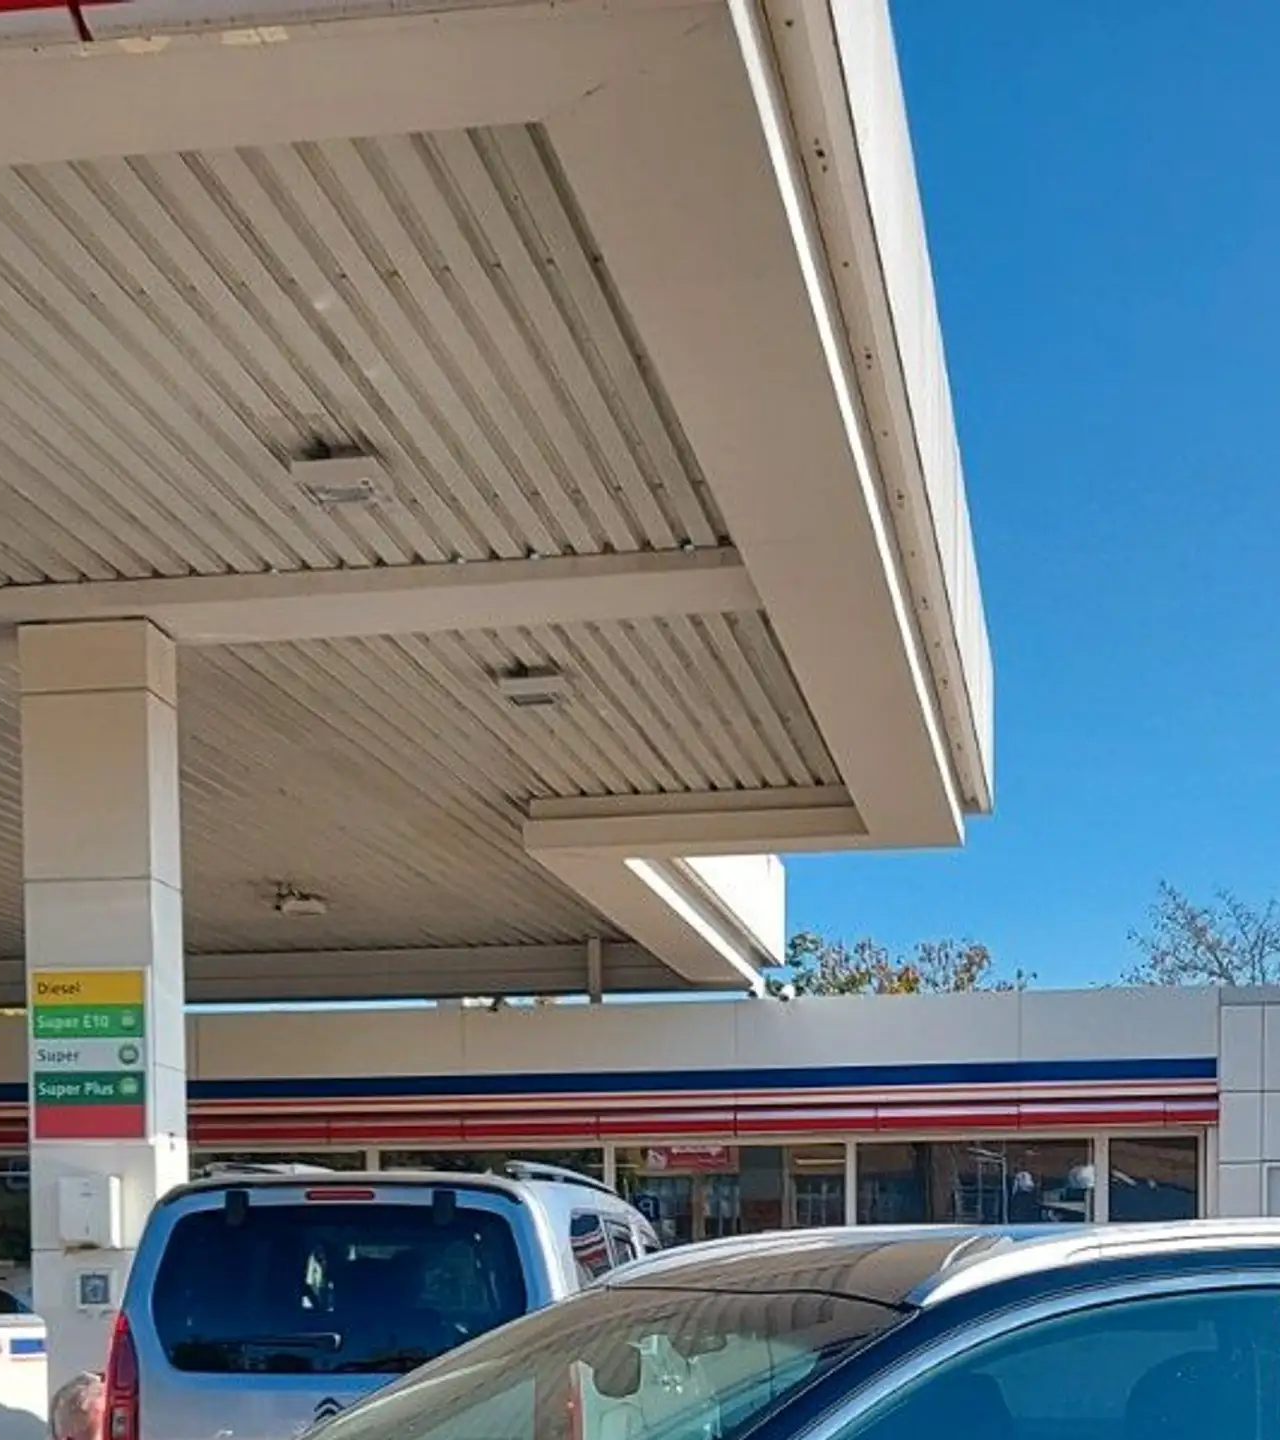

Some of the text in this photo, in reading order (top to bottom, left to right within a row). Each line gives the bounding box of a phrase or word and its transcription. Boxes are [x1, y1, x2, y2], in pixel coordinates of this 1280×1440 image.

[37, 981, 82, 996] Diesel
[37, 1014, 78, 1030] Super
[83, 1014, 109, 1029] E10
[37, 1048, 80, 1063] Super
[37, 1081, 82, 1098] Super
[84, 1080, 114, 1096] Plus
